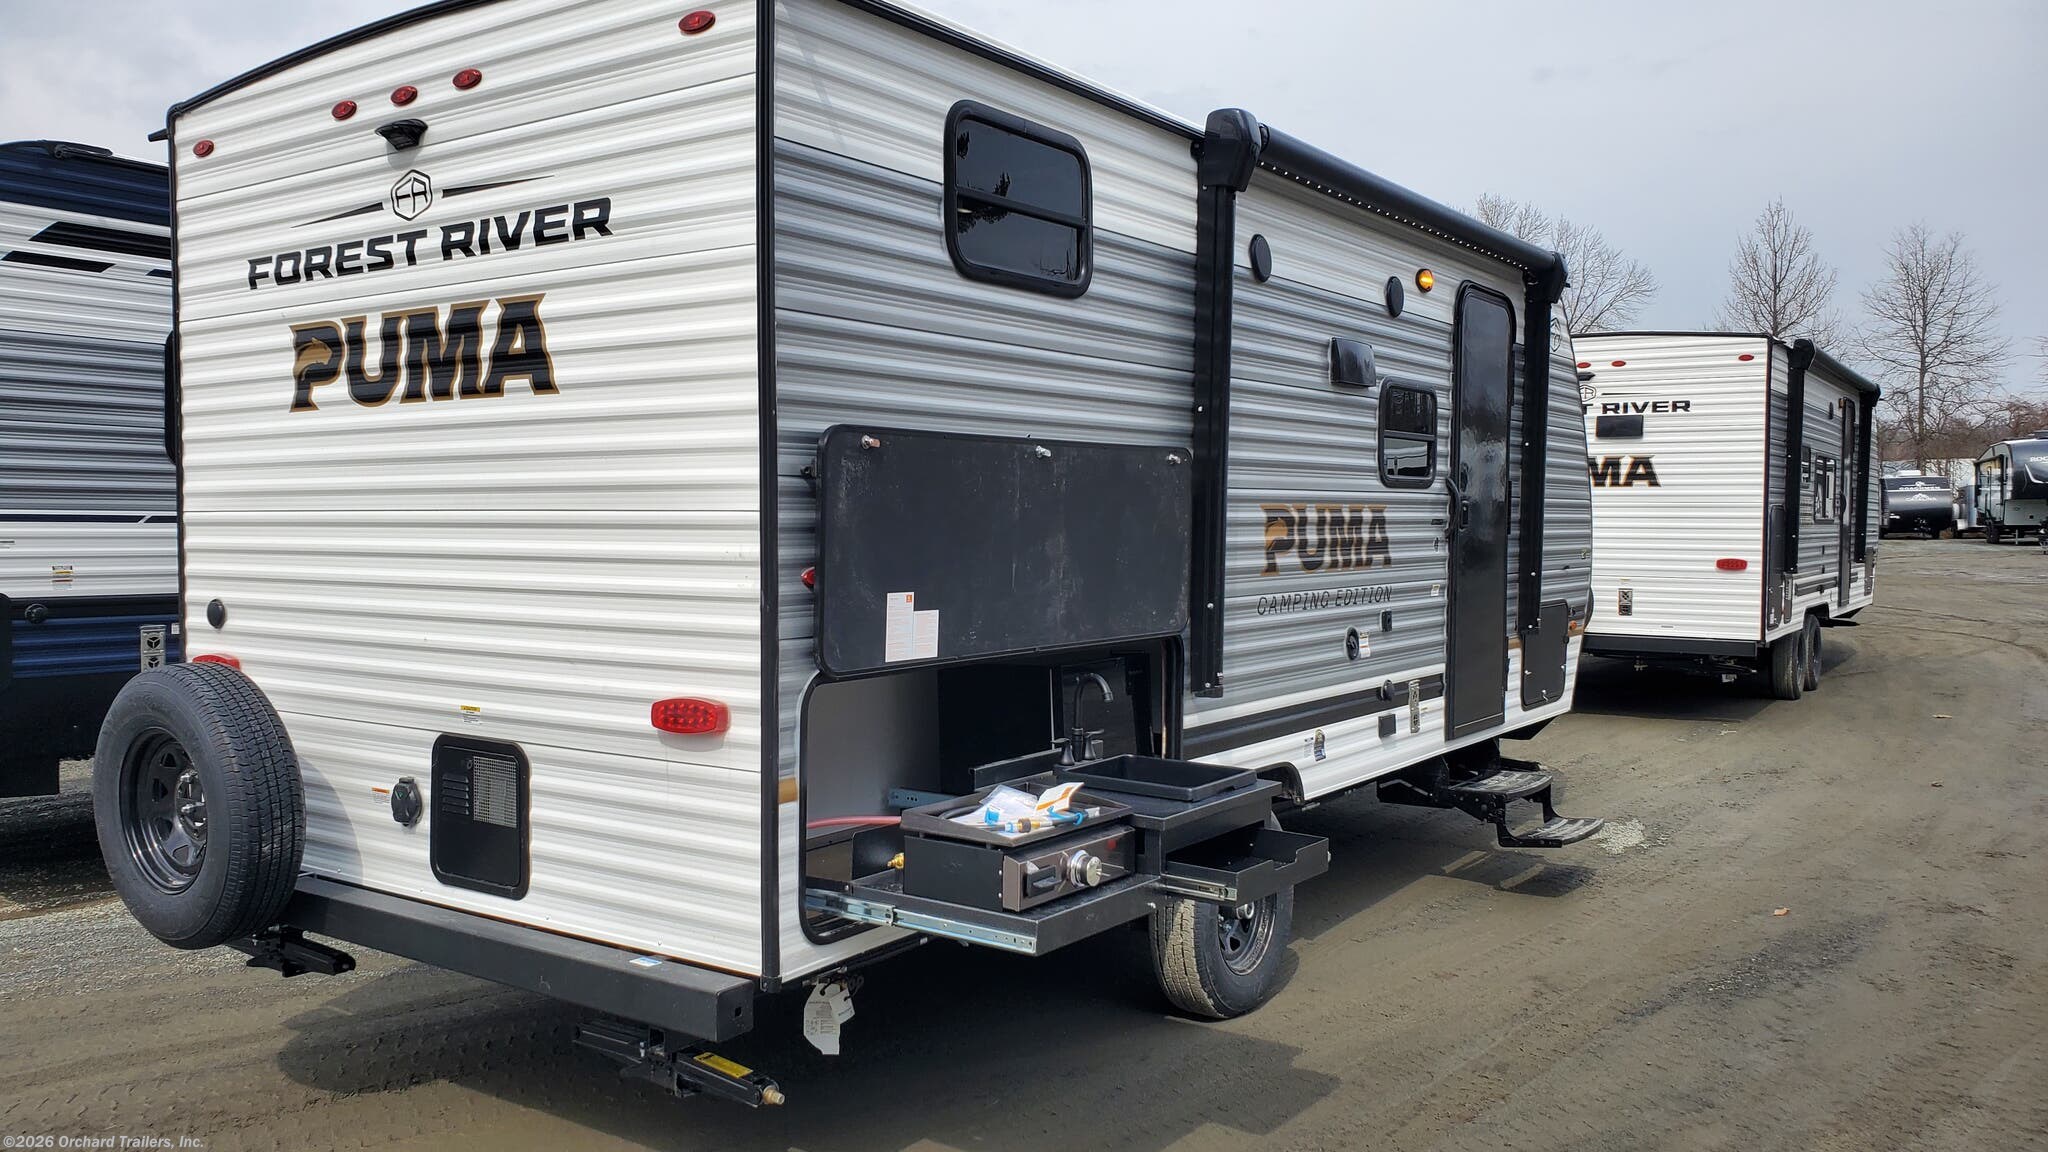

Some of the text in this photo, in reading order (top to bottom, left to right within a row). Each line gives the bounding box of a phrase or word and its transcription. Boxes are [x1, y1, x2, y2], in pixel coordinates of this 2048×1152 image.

[247, 197, 614, 290] FOREST RIVER
[288, 293, 561, 413] PUMA
[1601, 400, 1691, 414] RIVER
[1259, 503, 1393, 577] PUMA
[1257, 586, 1393, 616] CAMPING EDITION
